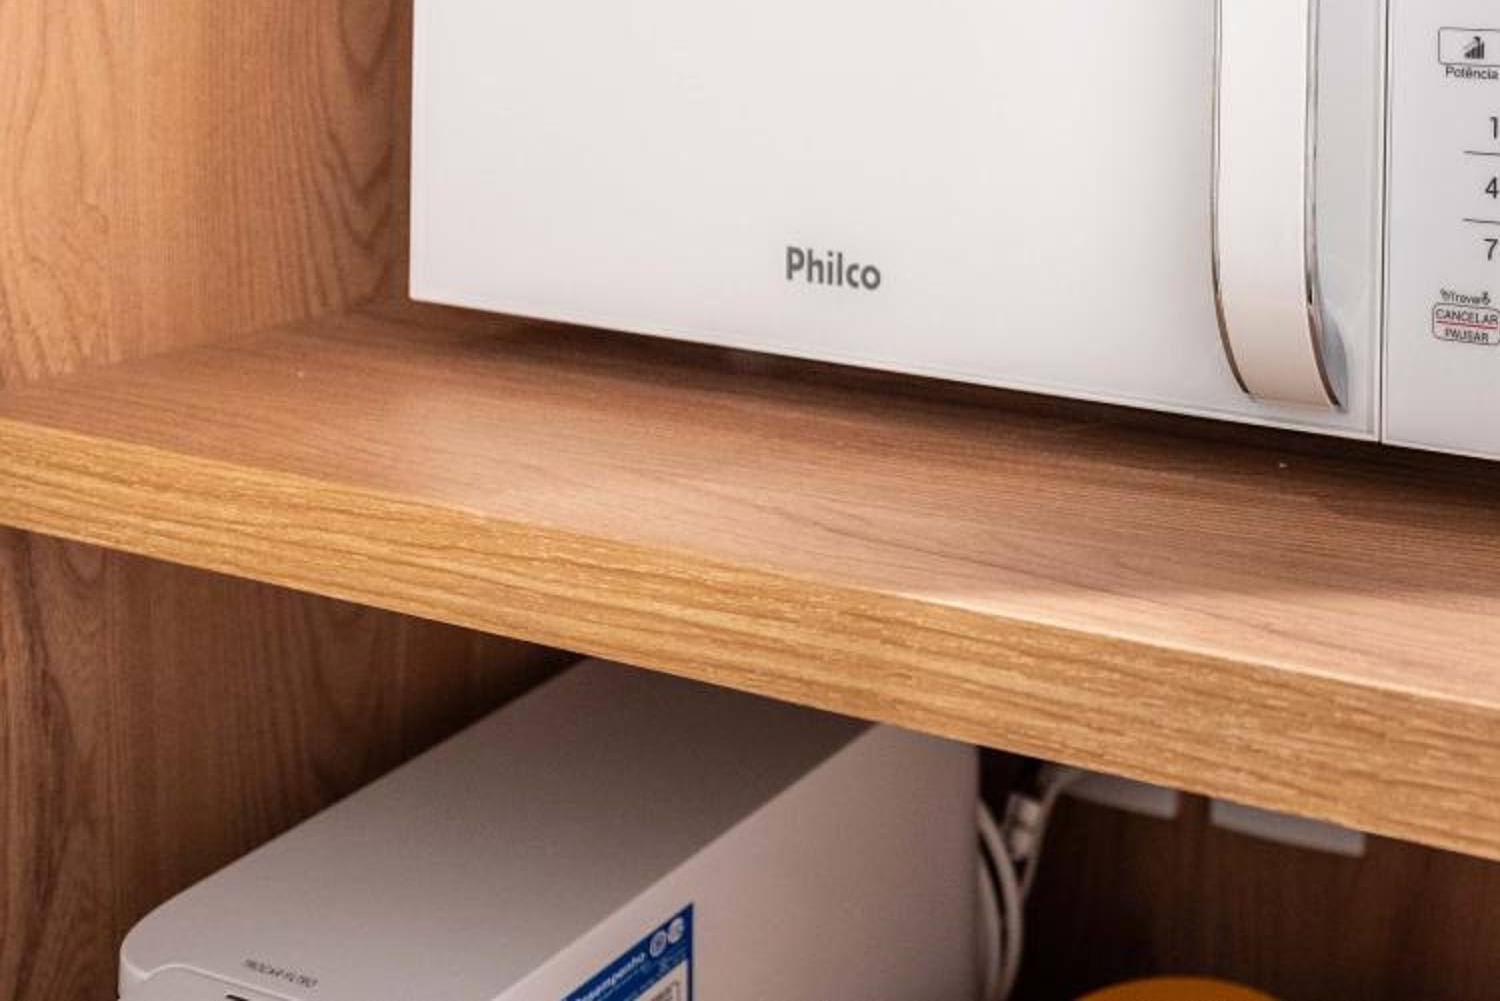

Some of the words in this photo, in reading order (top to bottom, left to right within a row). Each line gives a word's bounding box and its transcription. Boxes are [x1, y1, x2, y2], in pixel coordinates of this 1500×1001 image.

[1445, 65, 1499, 81] Potência
[1490, 116, 1500, 140] 1
[1484, 176, 1500, 200] 4
[1484, 238, 1499, 262] 7
[786, 246, 882, 291] Philco
[1435, 309, 1498, 325] CANCELAR
